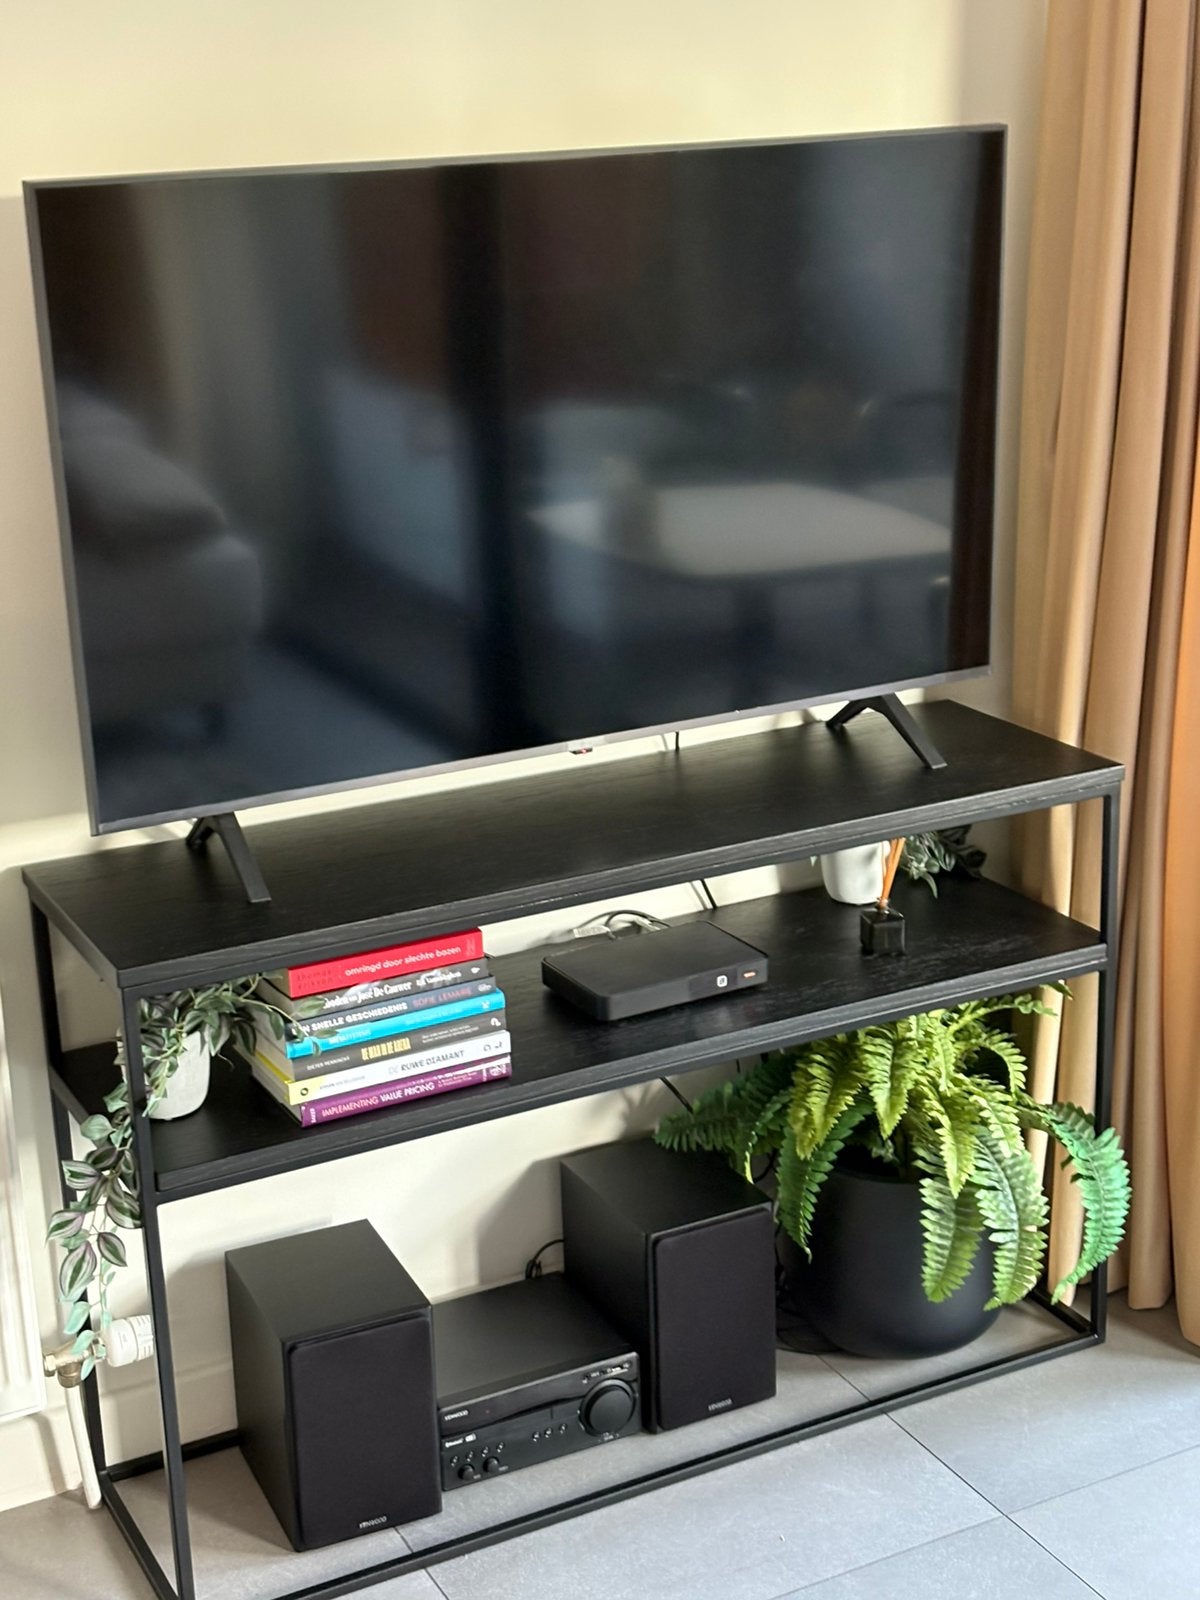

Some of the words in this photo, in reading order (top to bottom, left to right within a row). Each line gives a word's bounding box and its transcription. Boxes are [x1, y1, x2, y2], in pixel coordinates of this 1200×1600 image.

[344, 961, 382, 976] omringd
[383, 958, 403, 969] door
[404, 952, 434, 964] slechte
[435, 946, 461, 957] bazen
[311, 1016, 345, 1031] SNELLE
[345, 1001, 408, 1023] GESCHIEDENIS
[400, 1059, 424, 1071] RUWE
[425, 1050, 465, 1066] DIAMANT
[321, 1096, 379, 1117] IMPLEMENTING
[380, 1089, 403, 1102] VALUE
[404, 1082, 435, 1097] PRICING
